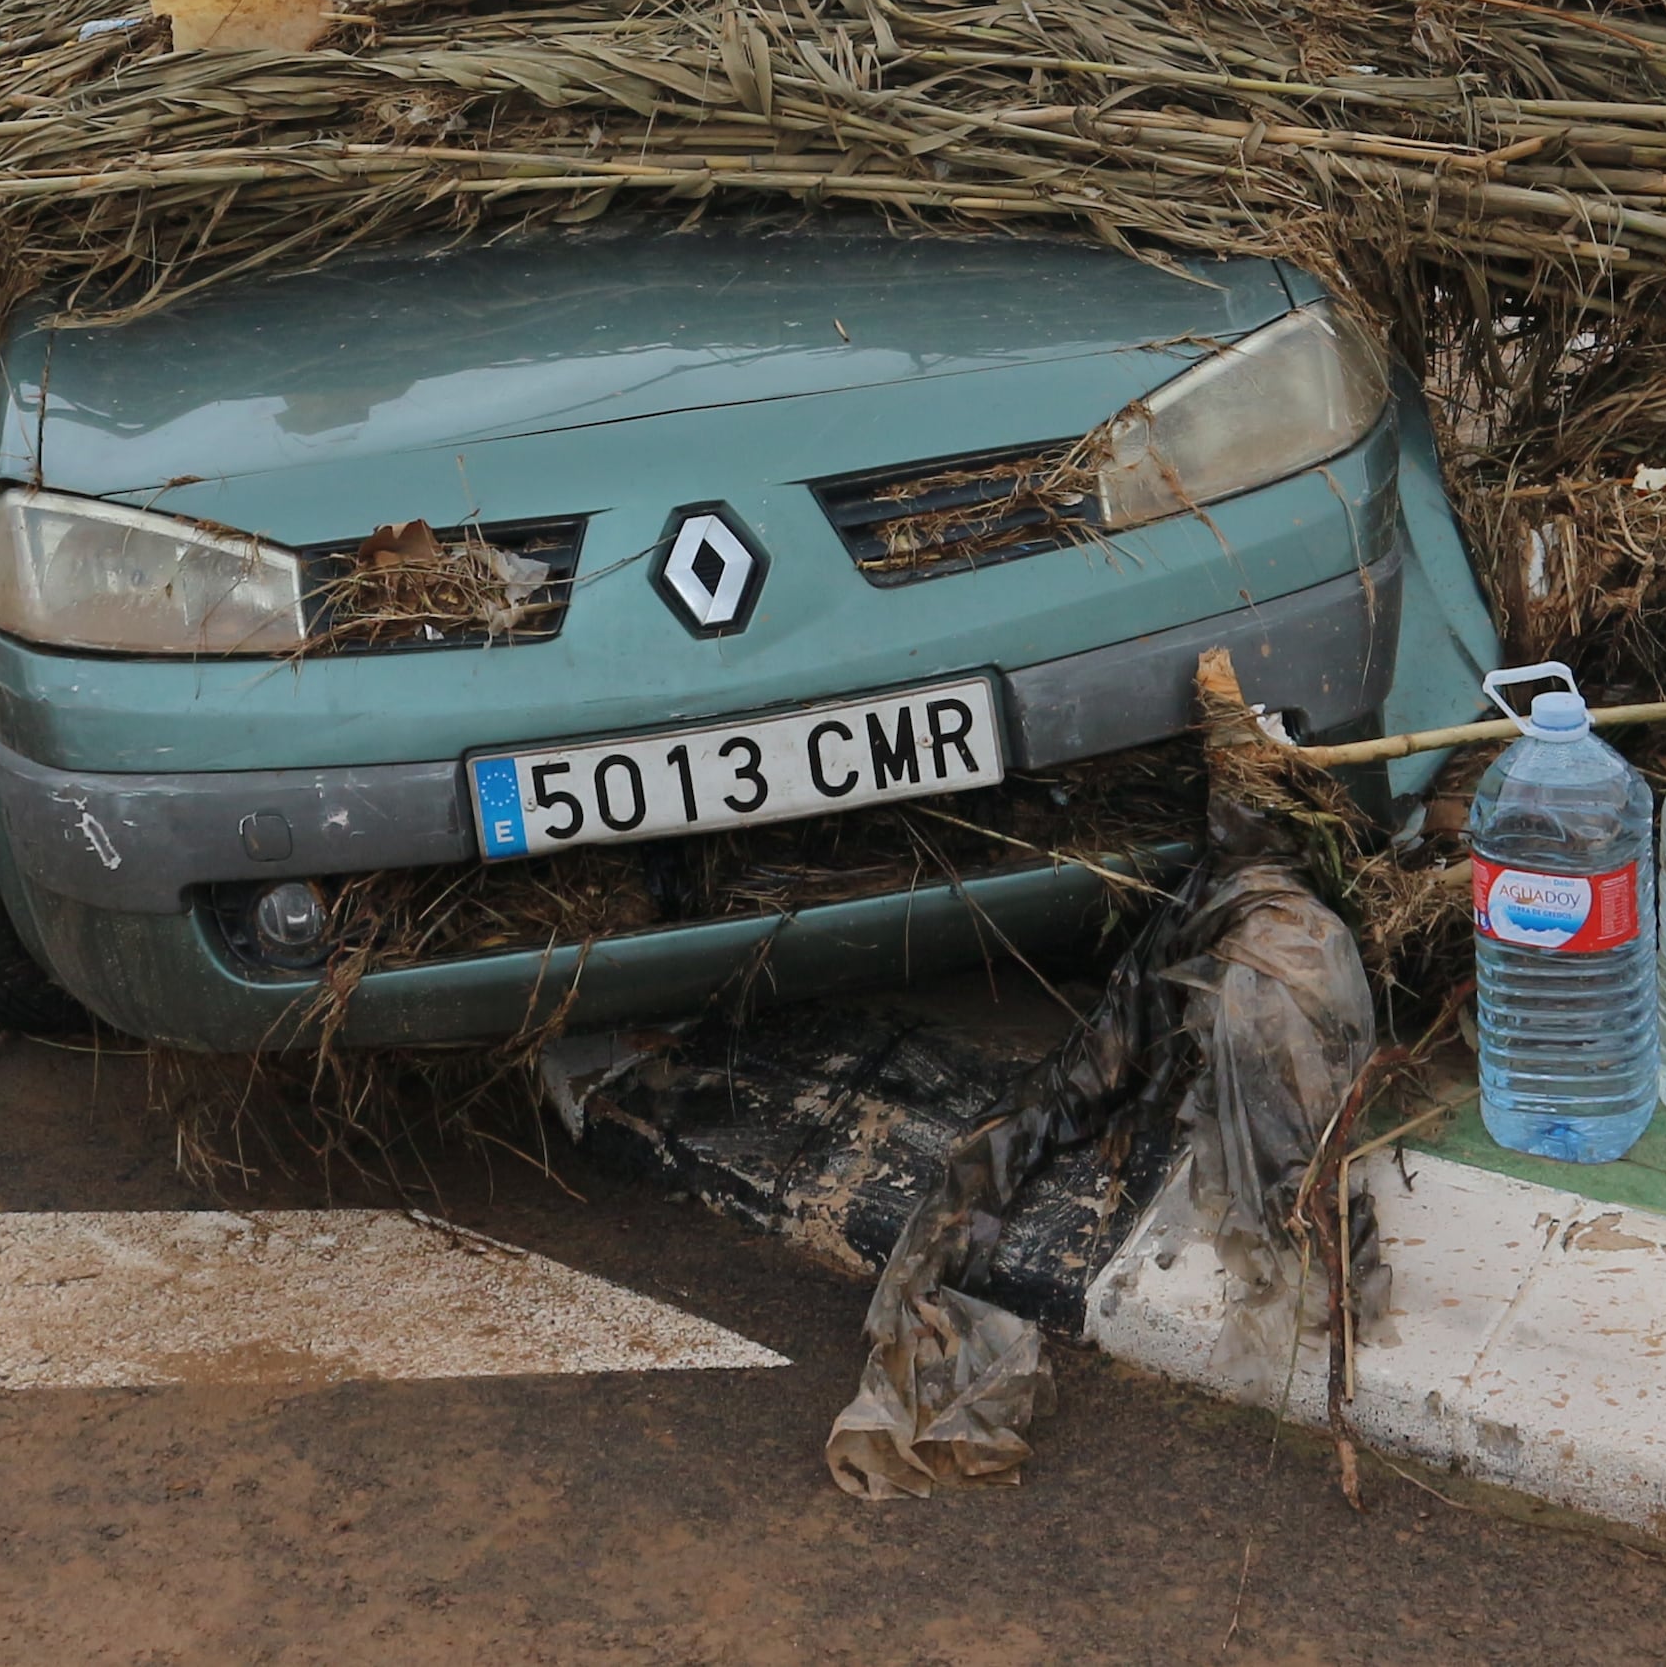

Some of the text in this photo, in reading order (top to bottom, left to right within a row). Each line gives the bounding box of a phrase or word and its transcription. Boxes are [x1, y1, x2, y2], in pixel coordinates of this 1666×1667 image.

[531, 698, 980, 840] 5013 CMR
[493, 820, 515, 844] E
